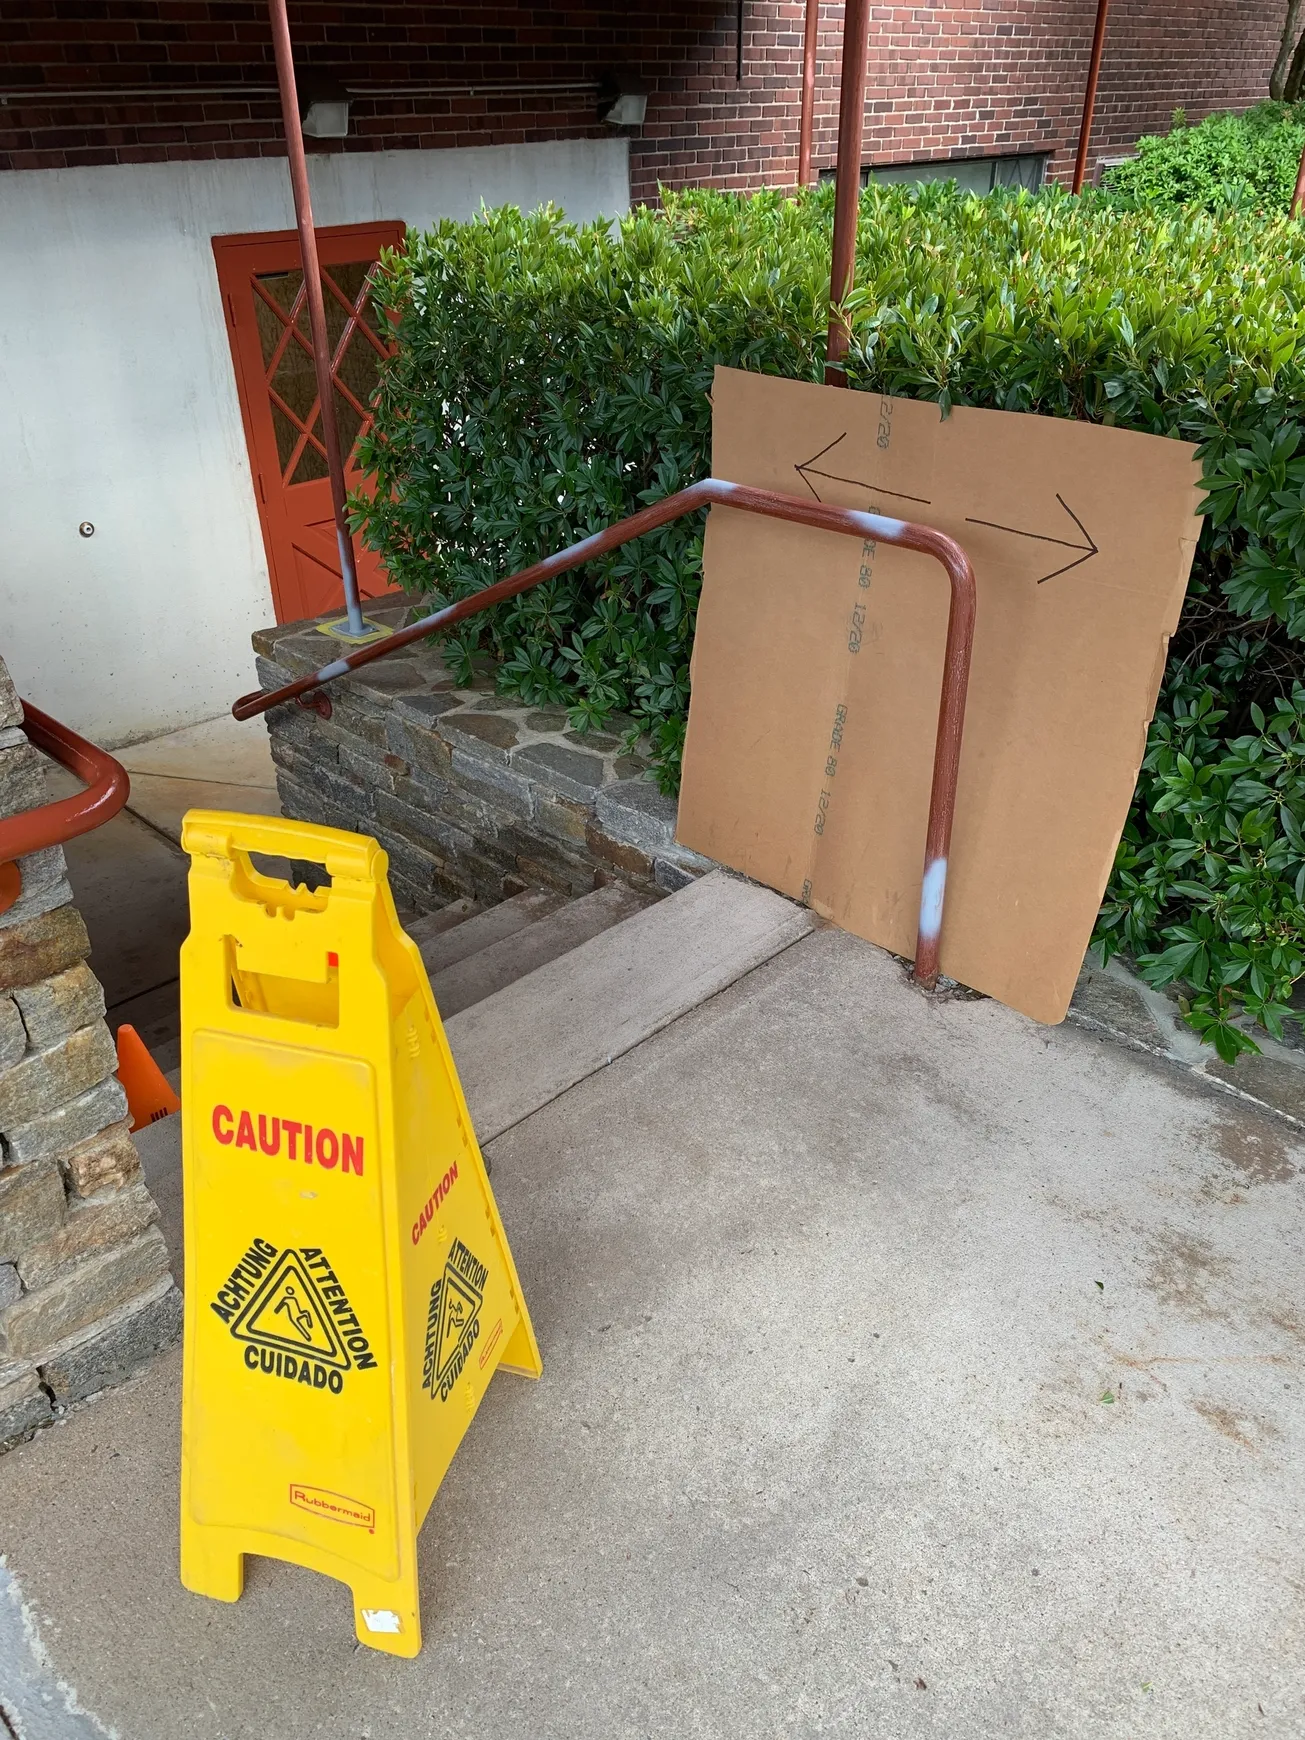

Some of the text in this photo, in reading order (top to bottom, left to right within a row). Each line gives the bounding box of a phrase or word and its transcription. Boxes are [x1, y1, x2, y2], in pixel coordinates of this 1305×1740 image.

[876, 394, 893, 449] 2/20
[849, 602, 866, 654] 12/20
[814, 704, 848, 836] GRADE 80 12/20
[212, 1104, 364, 1177] CAUTION
[411, 1160, 459, 1246] CAUTION
[210, 1238, 278, 1324] ACHTUNG
[448, 1237, 489, 1292] ATTENTION
[299, 1248, 378, 1371] ATTENTION
[422, 1278, 443, 1390] ACHTUNG
[244, 1345, 344, 1395] CUIDADO
[440, 1318, 480, 1403] CUIDADO
[294, 1490, 371, 1522] Rubbermaid
